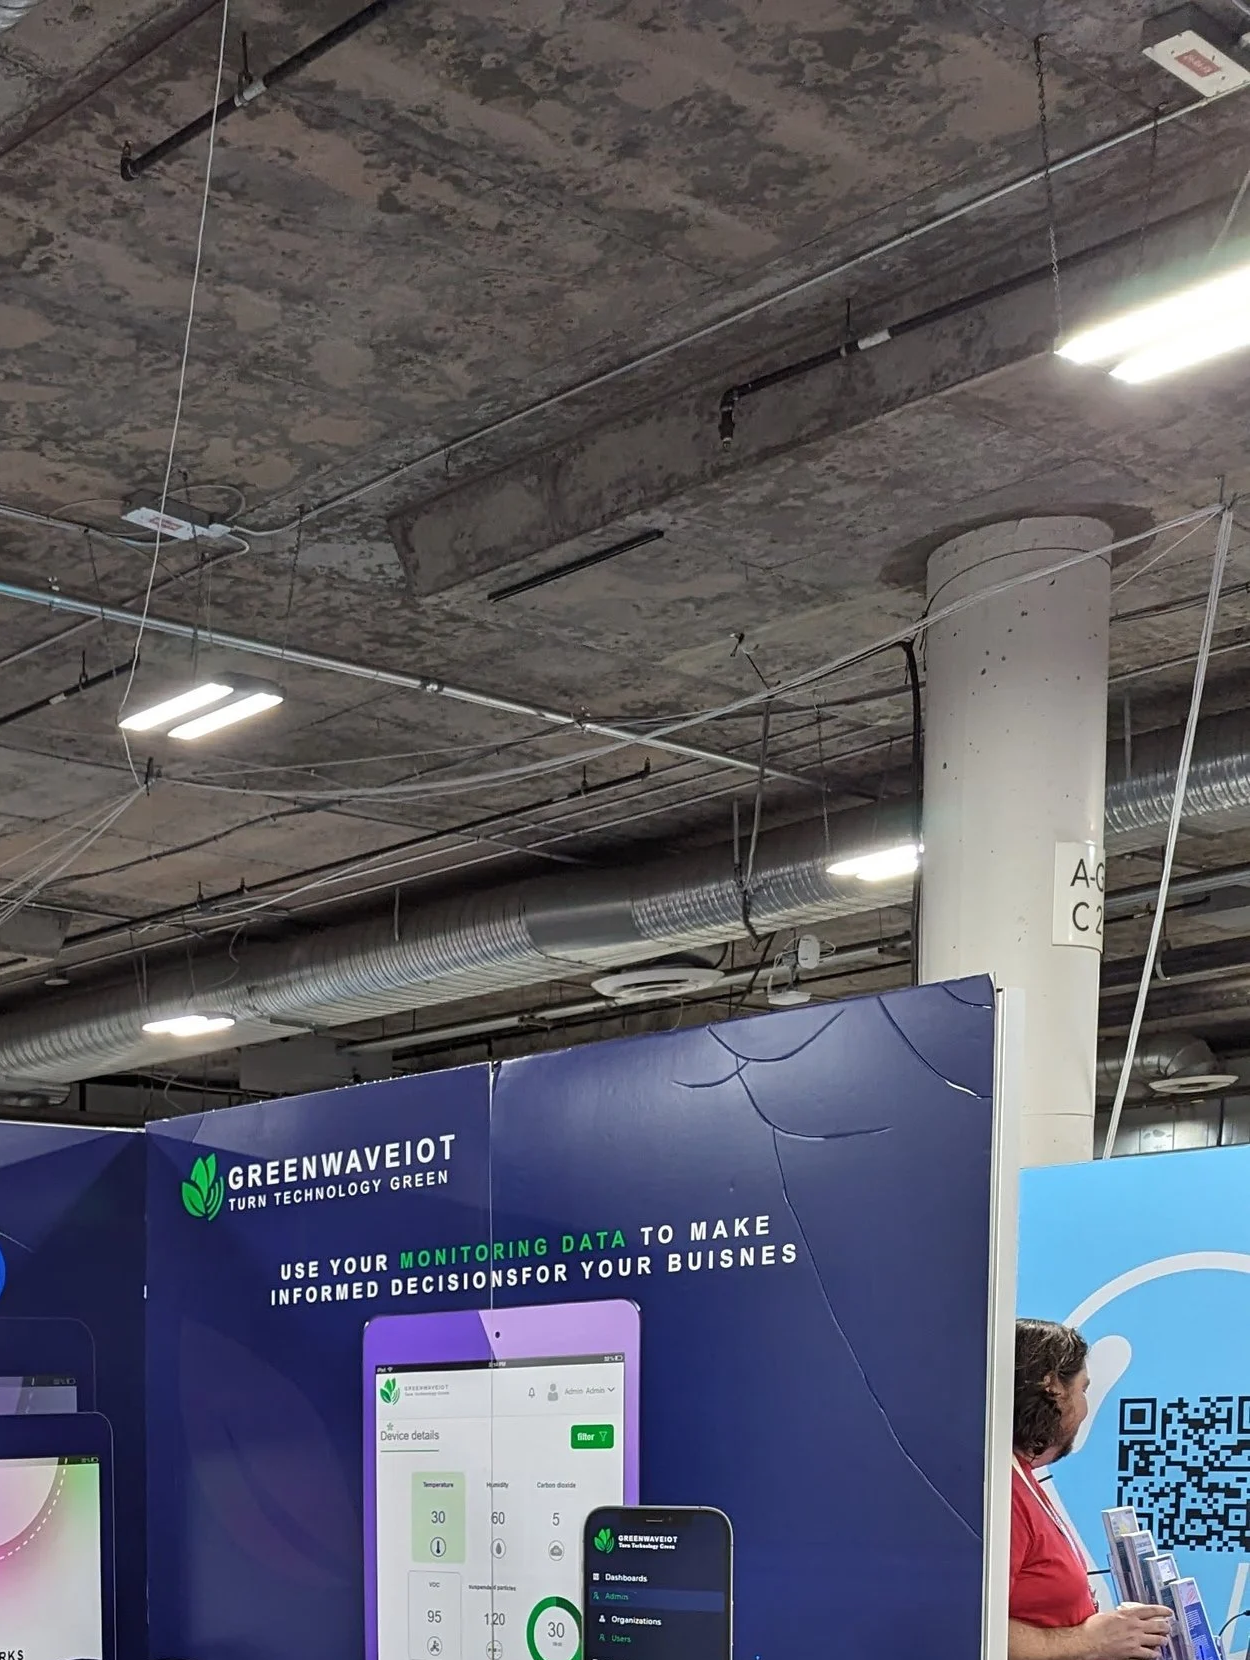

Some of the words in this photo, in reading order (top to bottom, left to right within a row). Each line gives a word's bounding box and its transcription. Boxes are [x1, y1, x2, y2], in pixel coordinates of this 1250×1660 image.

[1072, 901, 1089, 932] C
[227, 1134, 456, 1191] GREENWAVEIOT
[228, 1191, 268, 1211] TURN
[273, 1179, 382, 1206] TECHNOLOGY
[389, 1170, 449, 1190] GREEN
[280, 1261, 320, 1281] USE
[329, 1254, 388, 1276] YOUR
[399, 1238, 548, 1270] MONITORING
[561, 1230, 627, 1253] DATA
[640, 1225, 674, 1246] TO
[689, 1215, 771, 1241] MAKE
[269, 1282, 379, 1306] INFORMED
[390, 1263, 569, 1296] DECISIONSFOR
[580, 1256, 652, 1280] YOUR
[667, 1243, 798, 1273] BUISNES
[586, 1386, 606, 1394] Admin
[380, 1429, 409, 1441] Device
[411, 1428, 440, 1440] details
[577, 1432, 595, 1441] filter
[423, 1481, 454, 1489] Temperature
[486, 1481, 509, 1490] Humidity
[557, 1481, 577, 1489] dioxide
[431, 1510, 446, 1525] 30
[491, 1511, 506, 1525] 60
[552, 1512, 560, 1527] 5
[618, 1534, 678, 1543] GREENWAVEIOT
[605, 1573, 648, 1583] Dashboards
[605, 1592, 629, 1601] Admin
[427, 1610, 442, 1624] 95
[484, 1612, 506, 1626] 120
[611, 1615, 662, 1627] Organizations
[547, 1622, 565, 1639] 30
[611, 1634, 631, 1643] Users
